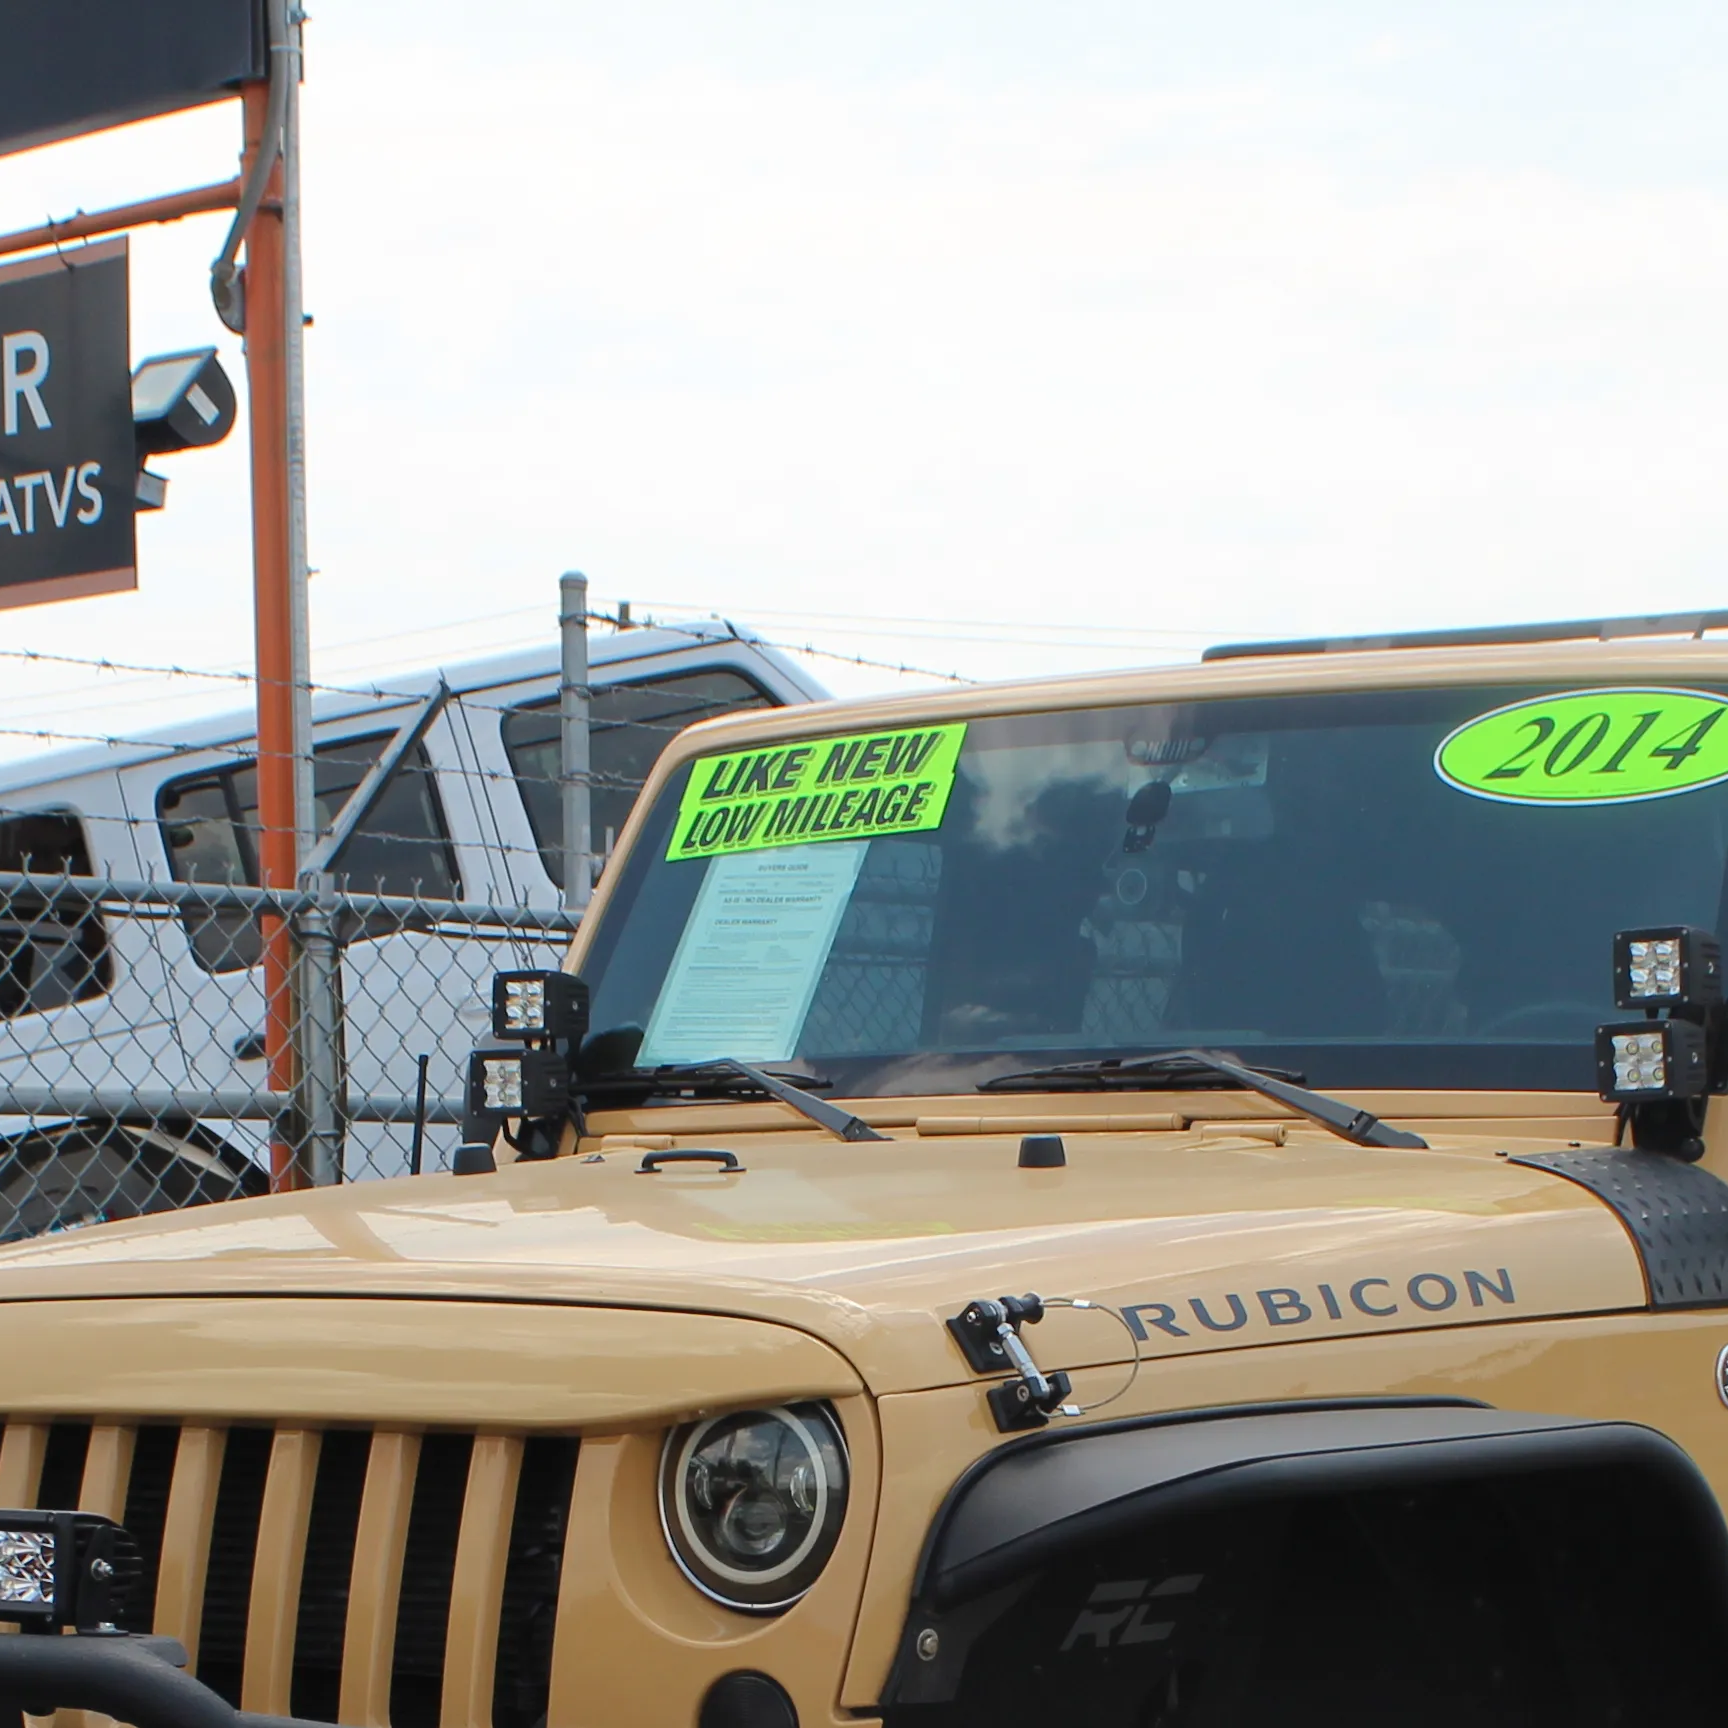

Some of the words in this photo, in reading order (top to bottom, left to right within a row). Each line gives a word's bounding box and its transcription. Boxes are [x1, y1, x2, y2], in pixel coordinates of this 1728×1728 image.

[700, 747, 817, 804] LIKE
[814, 731, 947, 789] NEW
[1481, 706, 1728, 781] 2014
[680, 801, 772, 855] LOW
[761, 781, 937, 843] MILEAGE
[1119, 1268, 1515, 1341] RUBICON
